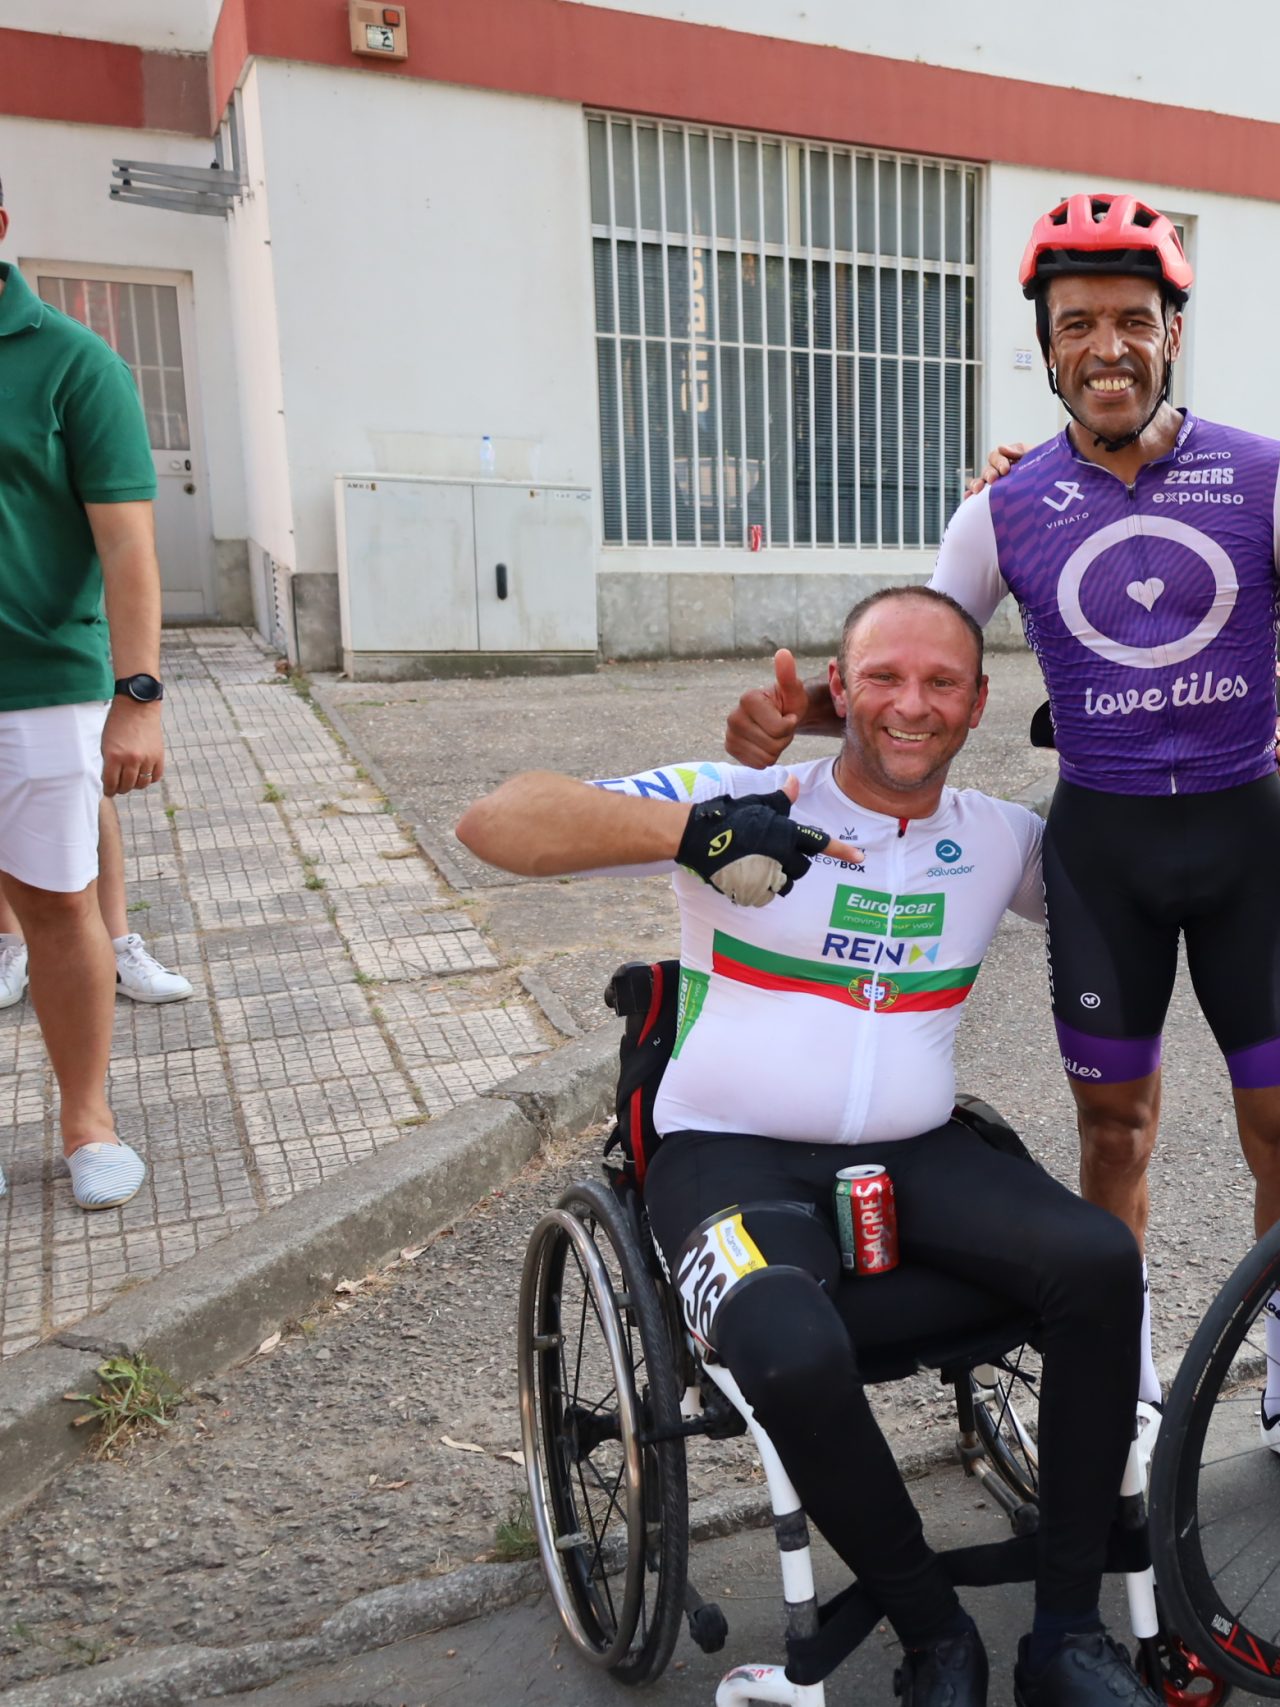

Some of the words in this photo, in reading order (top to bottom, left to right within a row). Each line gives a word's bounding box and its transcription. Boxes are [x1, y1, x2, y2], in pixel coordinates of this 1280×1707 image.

[1196, 451, 1231, 461] PACTO
[1163, 467, 1234, 485] 226ERS
[1152, 490, 1245, 505] expoluso
[1046, 511, 1090, 529] VIRIATO
[1084, 687, 1168, 716] love
[1171, 671, 1249, 708] tiles
[847, 893, 936, 915] Europcar
[843, 914, 881, 929] moving
[821, 933, 905, 966] REN
[856, 1181, 887, 1270] SAGRES
[1211, 1613, 1233, 1636] RACING
